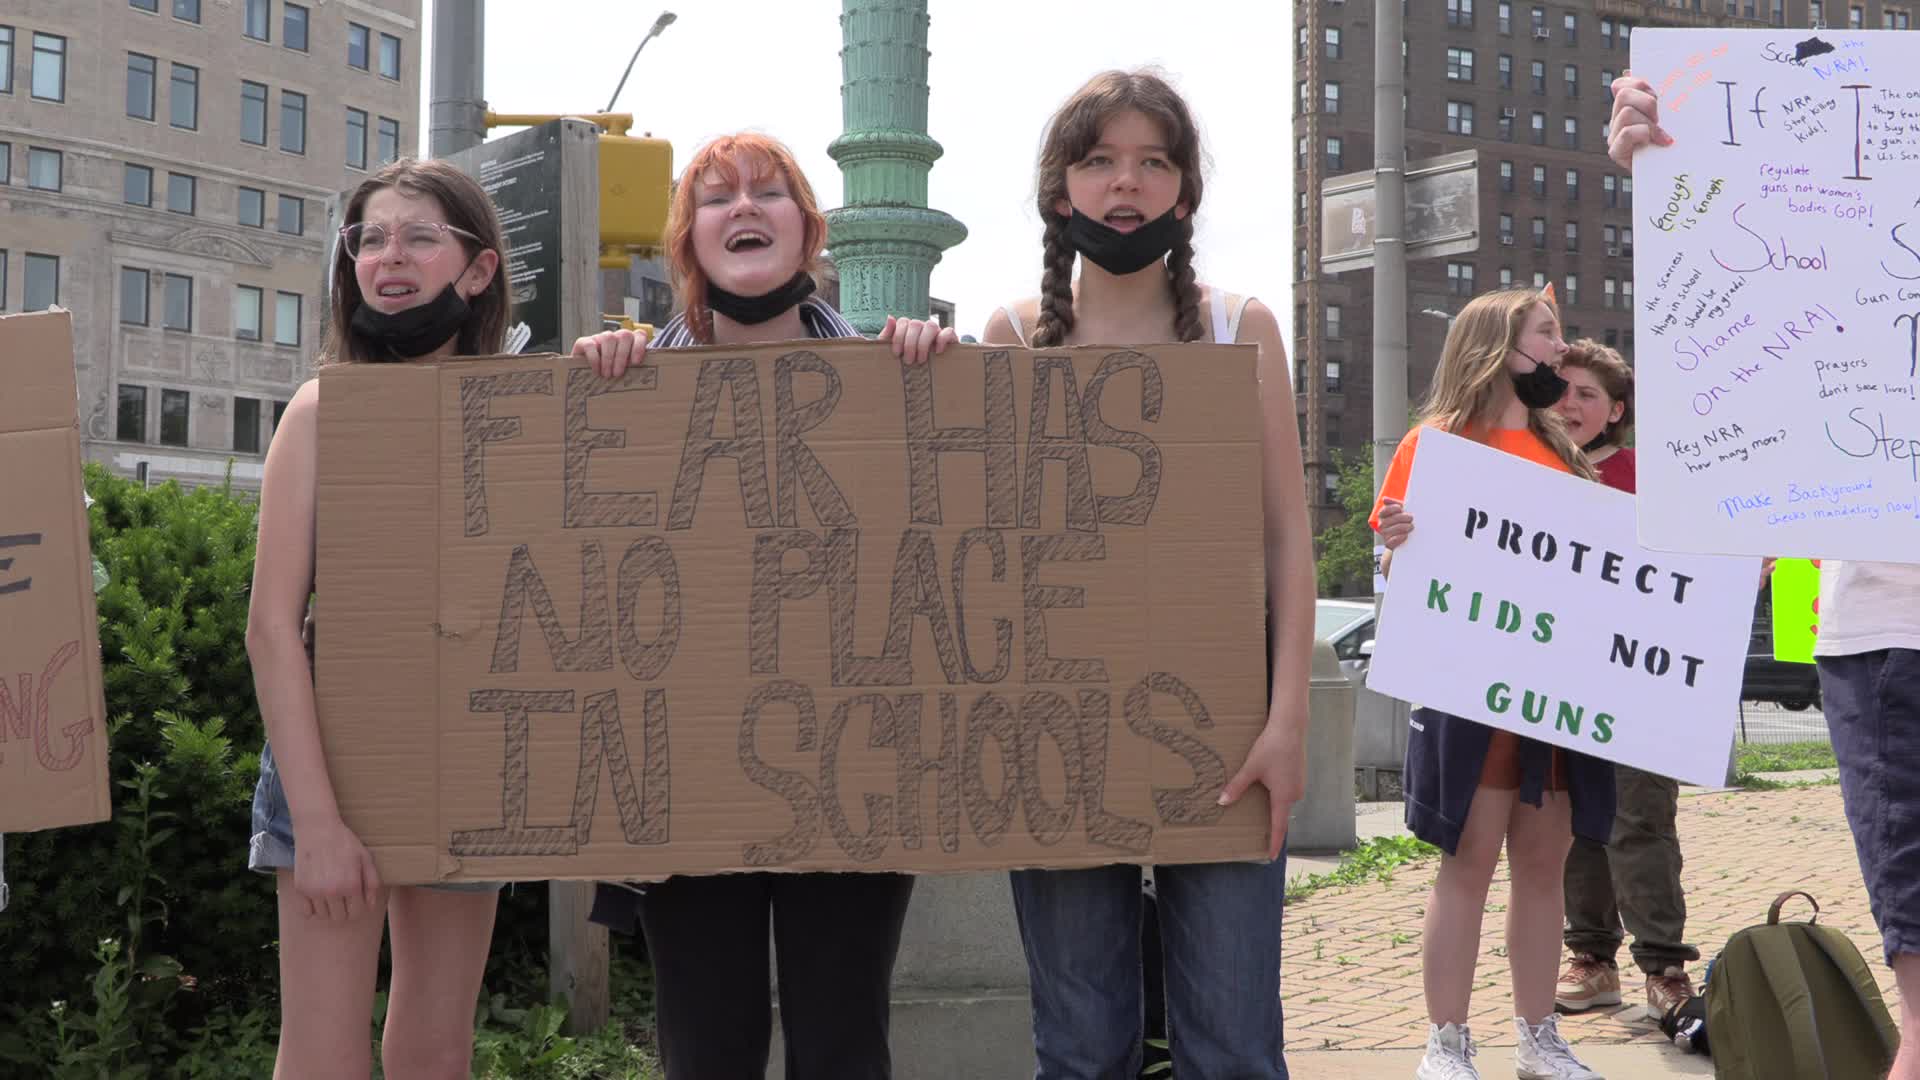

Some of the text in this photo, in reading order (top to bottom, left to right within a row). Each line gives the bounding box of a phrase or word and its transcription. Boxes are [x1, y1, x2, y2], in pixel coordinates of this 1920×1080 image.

[1813, 56, 1869, 80] NRA!
[1782, 96, 1812, 115] NRA
[1880, 89, 1900, 100] The
[1716, 81, 1766, 146] If
[1884, 122, 1904, 135] buy
[1880, 139, 1902, 150] gun
[1760, 184, 1788, 199] guns
[1795, 183, 1813, 193] not
[1682, 217, 1697, 230] is
[1789, 197, 1873, 227] bodies GOP!
[1710, 202, 1827, 272] School
[1856, 287, 1889, 305] Gun
[1650, 312, 1678, 336] thing
[1708, 305, 1725, 320] my
[1674, 314, 1756, 370] Shame
[1730, 363, 1763, 383] the
[1763, 304, 1844, 360] NRA!
[1819, 384, 1848, 399] don't
[461, 350, 1163, 538] FEAR HAS
[1667, 424, 1744, 456] Hey NRA
[1685, 430, 1786, 473] how many more?
[1717, 494, 1773, 519] Make
[1465, 507, 1694, 604] PROTECT
[490, 528, 1110, 686] NO PLACE
[1427, 578, 1705, 688] KIDS NOT
[1486, 681, 1615, 744] GUNS
[449, 671, 1228, 866] IN SCHOOLS
